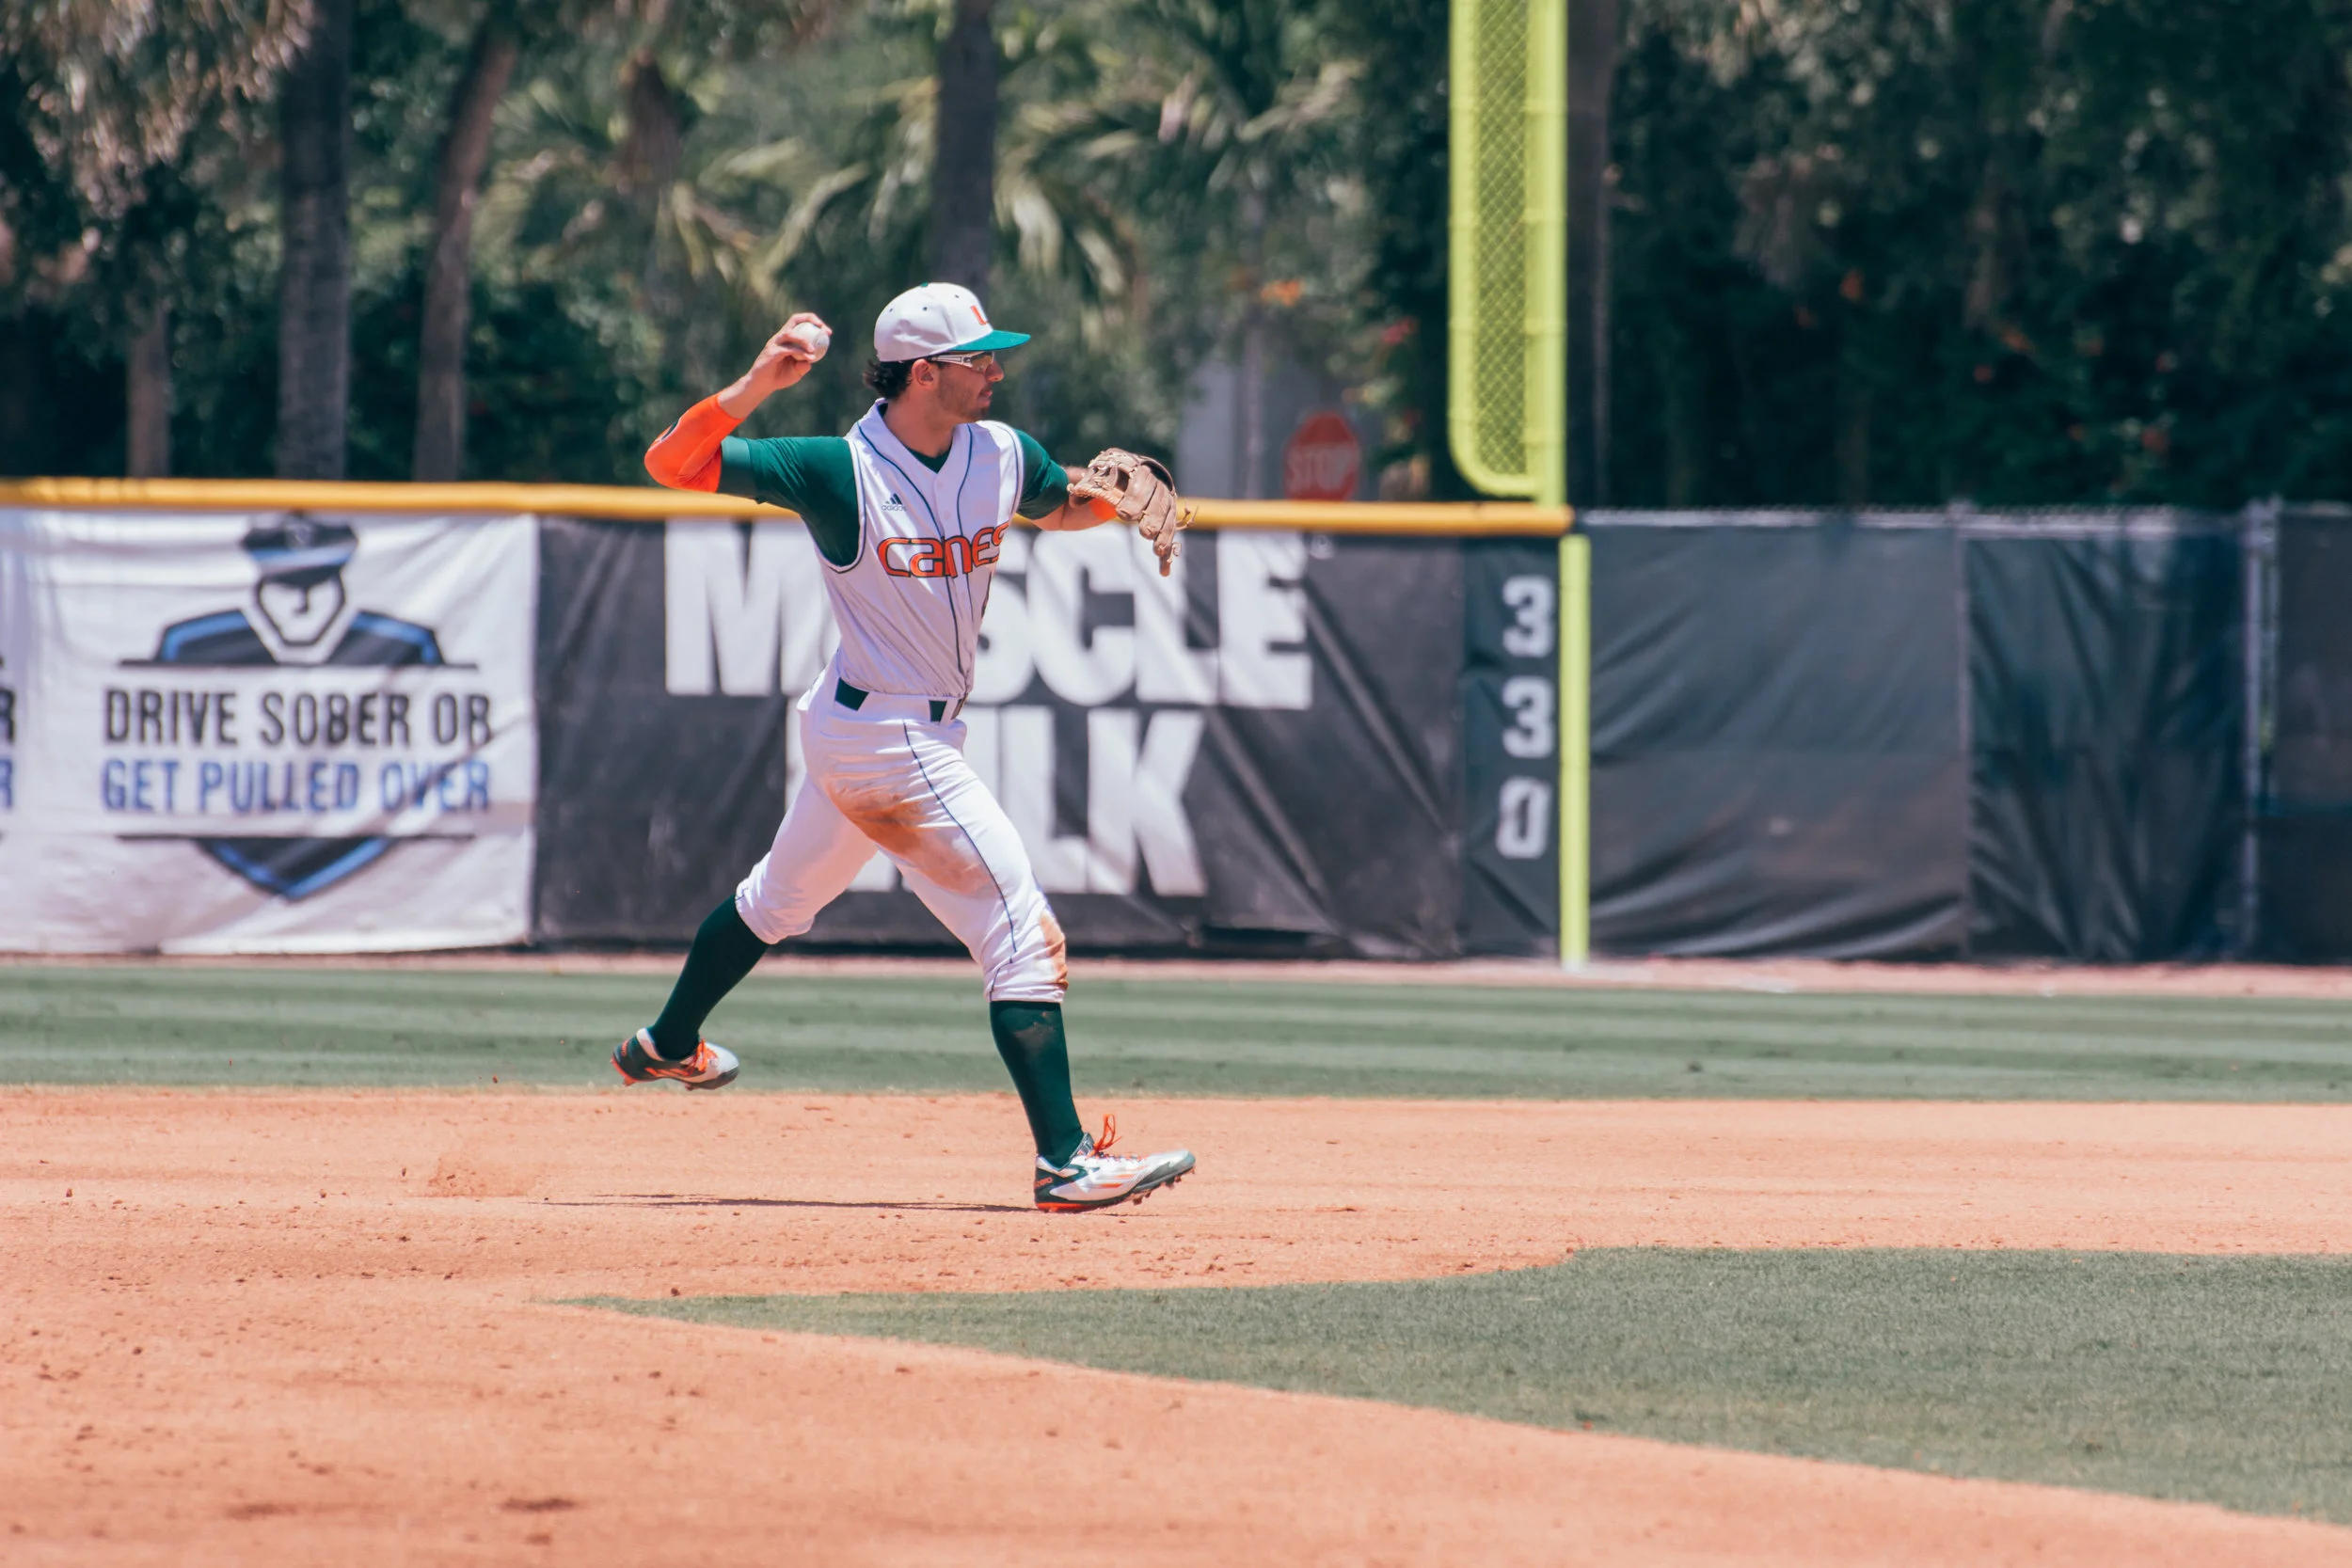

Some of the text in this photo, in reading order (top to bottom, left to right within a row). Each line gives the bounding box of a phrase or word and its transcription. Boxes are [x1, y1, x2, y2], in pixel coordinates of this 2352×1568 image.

[664, 520, 1313, 710] MSCLE
[105, 688, 492, 747] DRIVE SOBER OR
[102, 758, 490, 816] GET PULLED OVER
